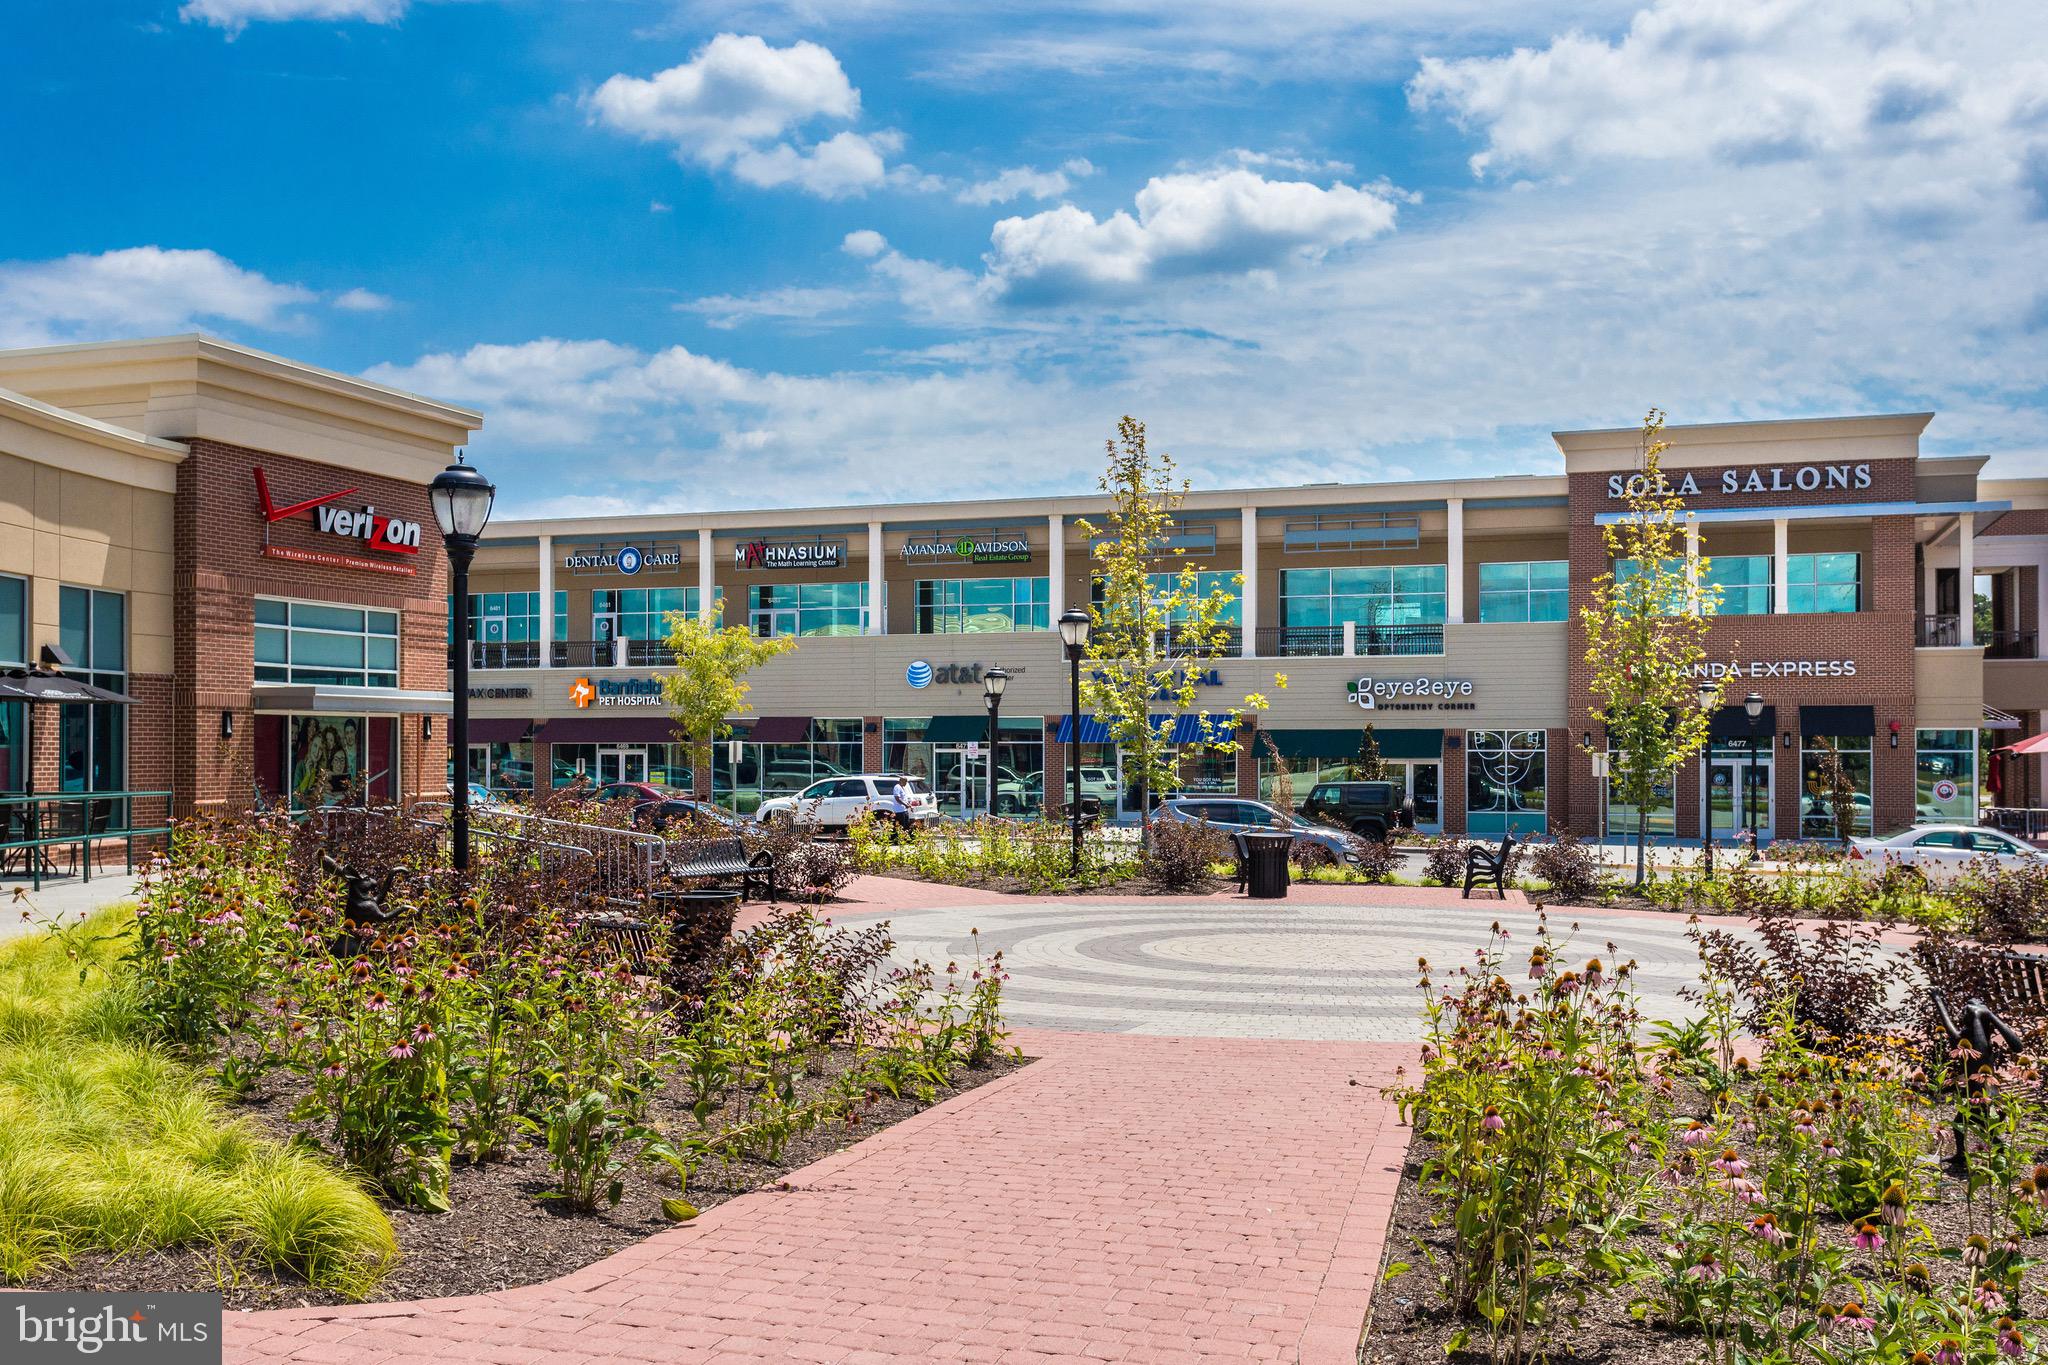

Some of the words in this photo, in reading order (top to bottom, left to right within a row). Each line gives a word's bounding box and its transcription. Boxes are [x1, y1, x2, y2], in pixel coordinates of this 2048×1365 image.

[1608, 472, 1701, 498] SOLA
[1722, 464, 1872, 494] SALONS
[317, 506, 420, 554] verizon
[271, 548, 284, 556] The
[285, 550, 316, 560] Wireless
[318, 554, 340, 563] Center
[900, 544, 952, 555] AMANDA
[565, 555, 617, 568] DENTAL
[644, 553, 680, 566] CARE
[793, 560, 817, 568] Learning
[1008, 553, 1029, 562] Group
[345, 558, 369, 568] Premium
[369, 562, 392, 571] Wireless
[392, 565, 414, 574] Retailer
[935, 662, 983, 684] at&t
[1671, 662, 1742, 678] ANDA
[1750, 661, 1857, 677] EXPRESS
[486, 688, 529, 699] CENTER
[599, 679, 662, 695] Banfield
[1374, 678, 1472, 699] eye2eye
[599, 697, 616, 706] PET
[618, 696, 662, 706] HOSPITAL
[1377, 703, 1433, 711] OPTOMETRY
